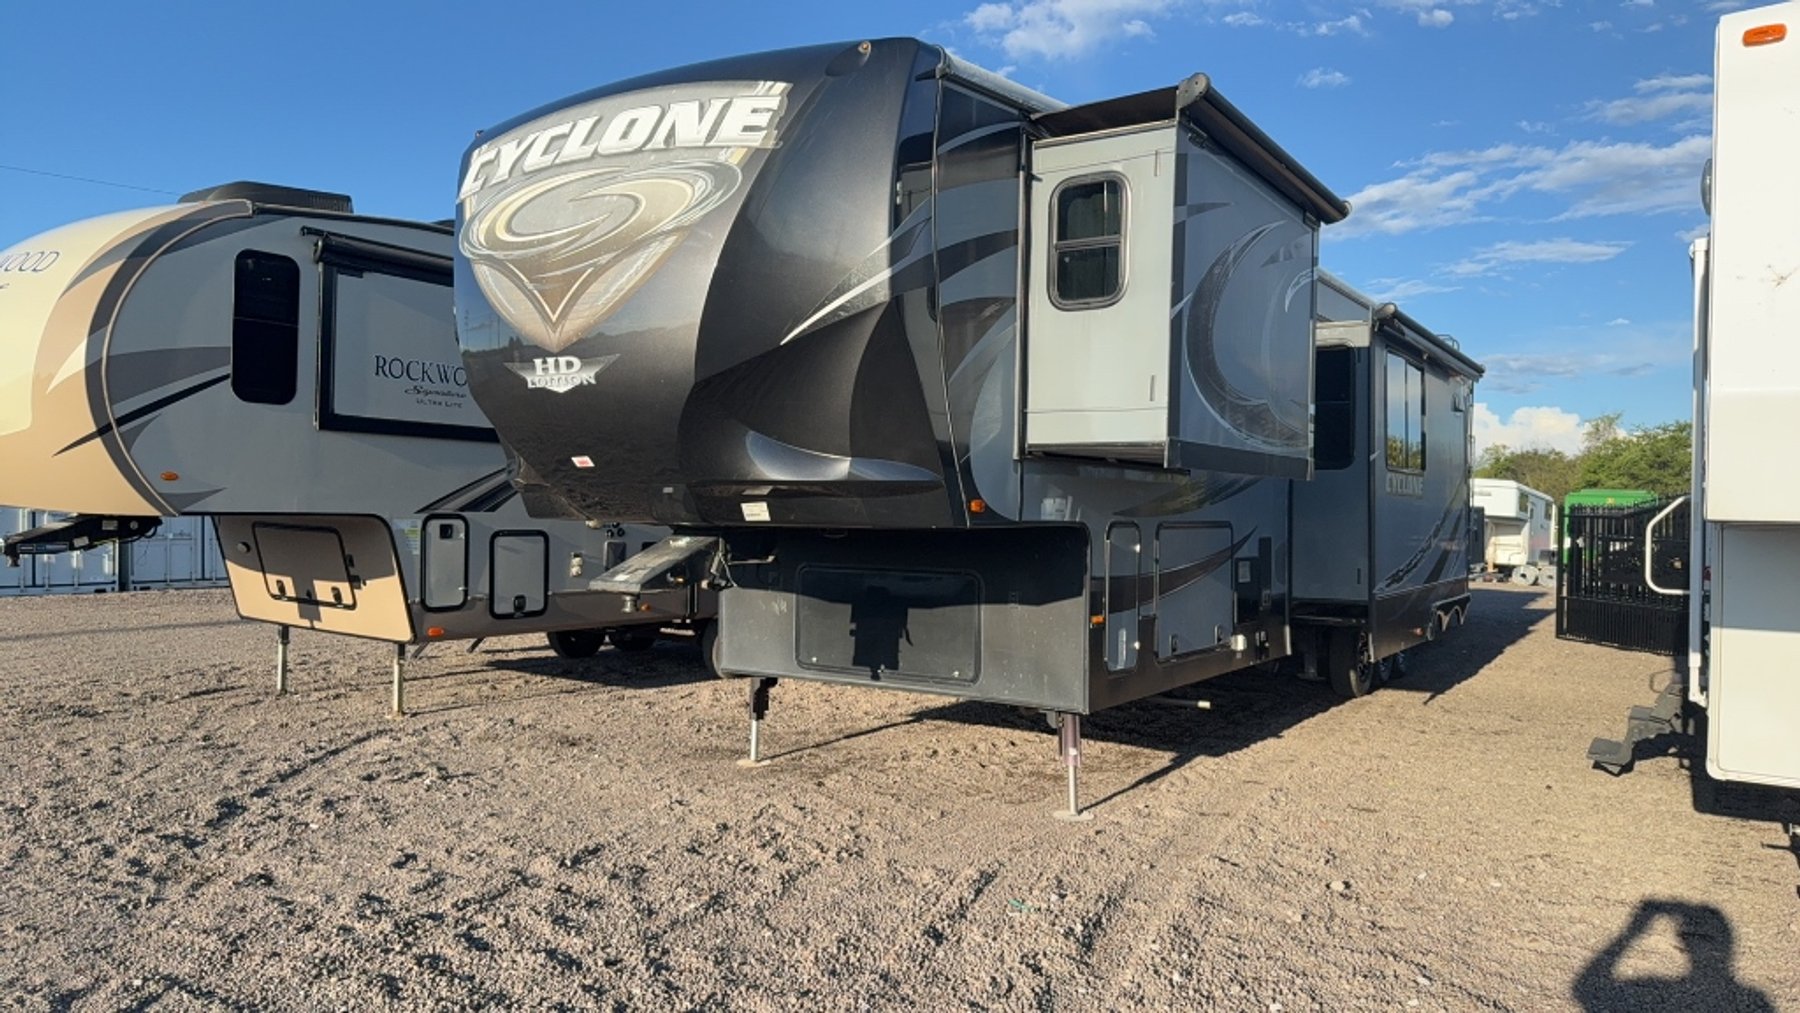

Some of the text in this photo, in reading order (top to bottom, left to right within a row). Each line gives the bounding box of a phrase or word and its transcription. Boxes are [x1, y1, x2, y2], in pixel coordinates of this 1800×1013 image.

[456, 94, 781, 202] CYCLONE
[533, 356, 582, 376] HD
[1385, 472, 1424, 497] CYCLONE
